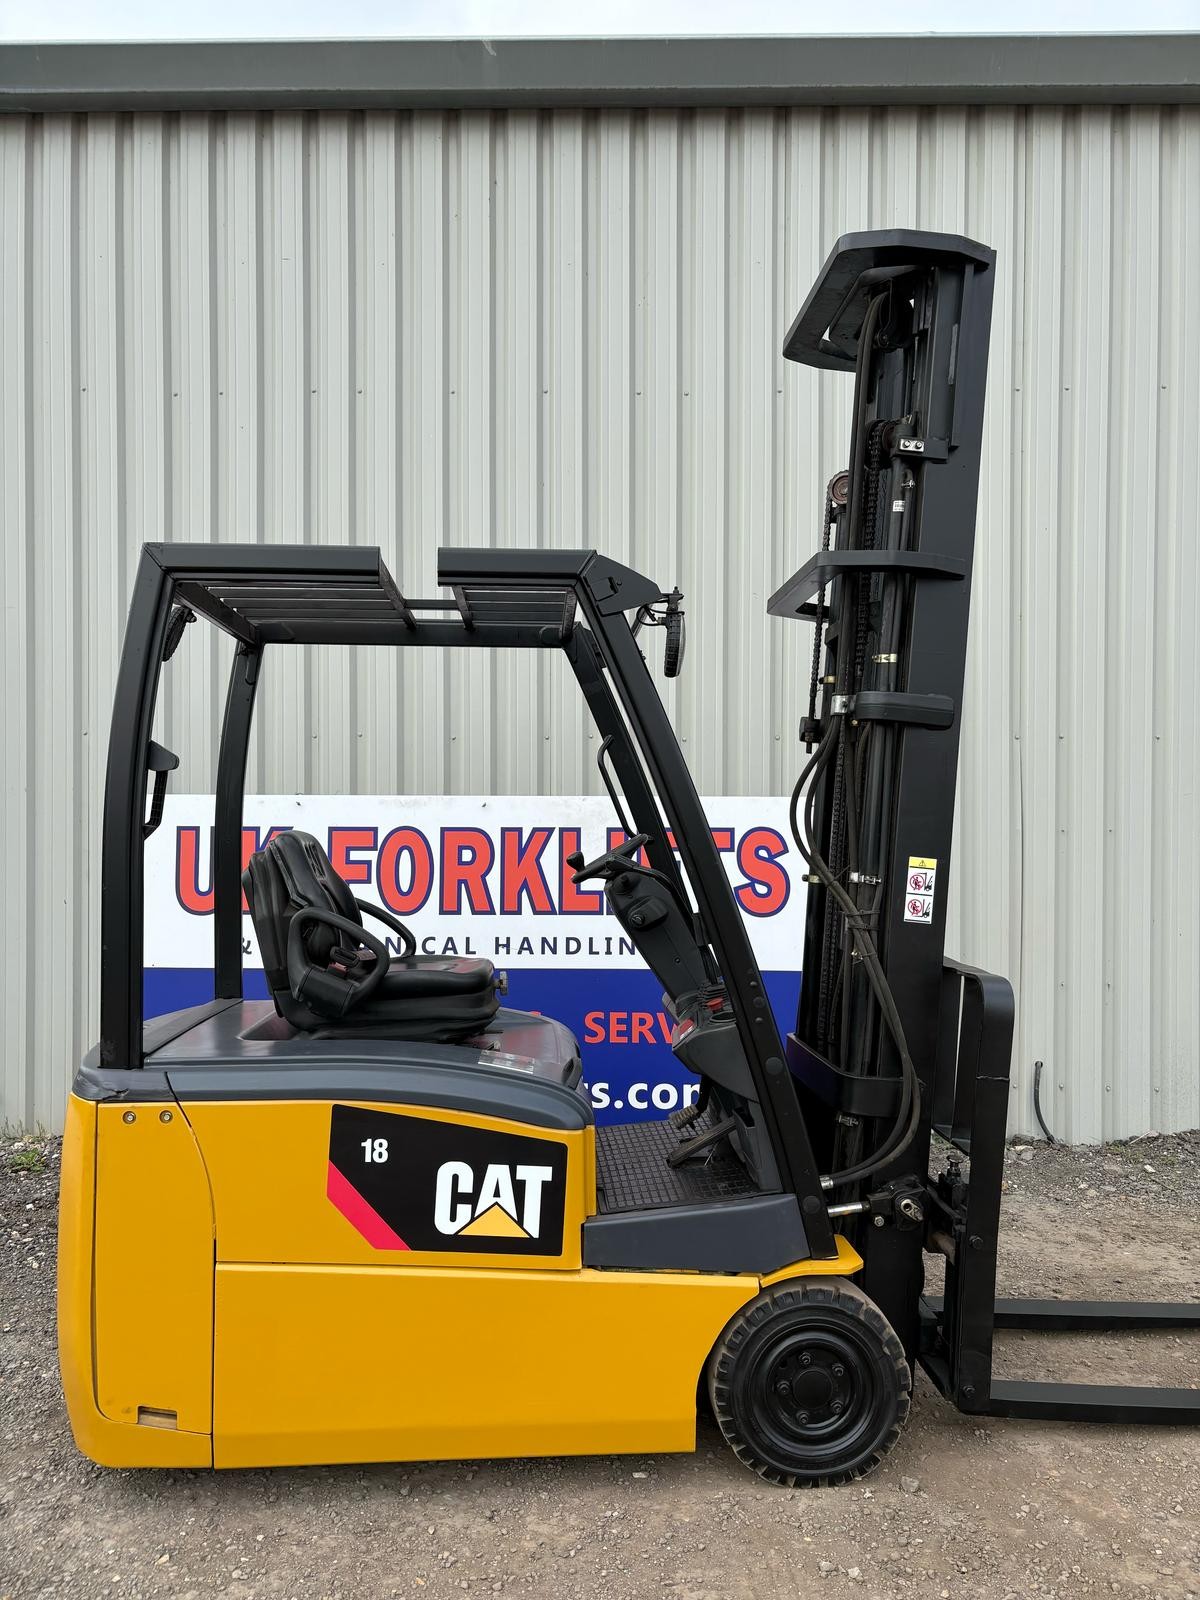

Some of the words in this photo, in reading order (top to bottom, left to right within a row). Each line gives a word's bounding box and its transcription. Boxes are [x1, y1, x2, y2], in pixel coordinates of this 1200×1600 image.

[328, 826, 791, 917] FORKLS
[494, 937, 636, 955] HANDLIN
[584, 1011, 676, 1044] SERV
[361, 1138, 389, 1163] 18
[434, 1161, 553, 1239] CAT
